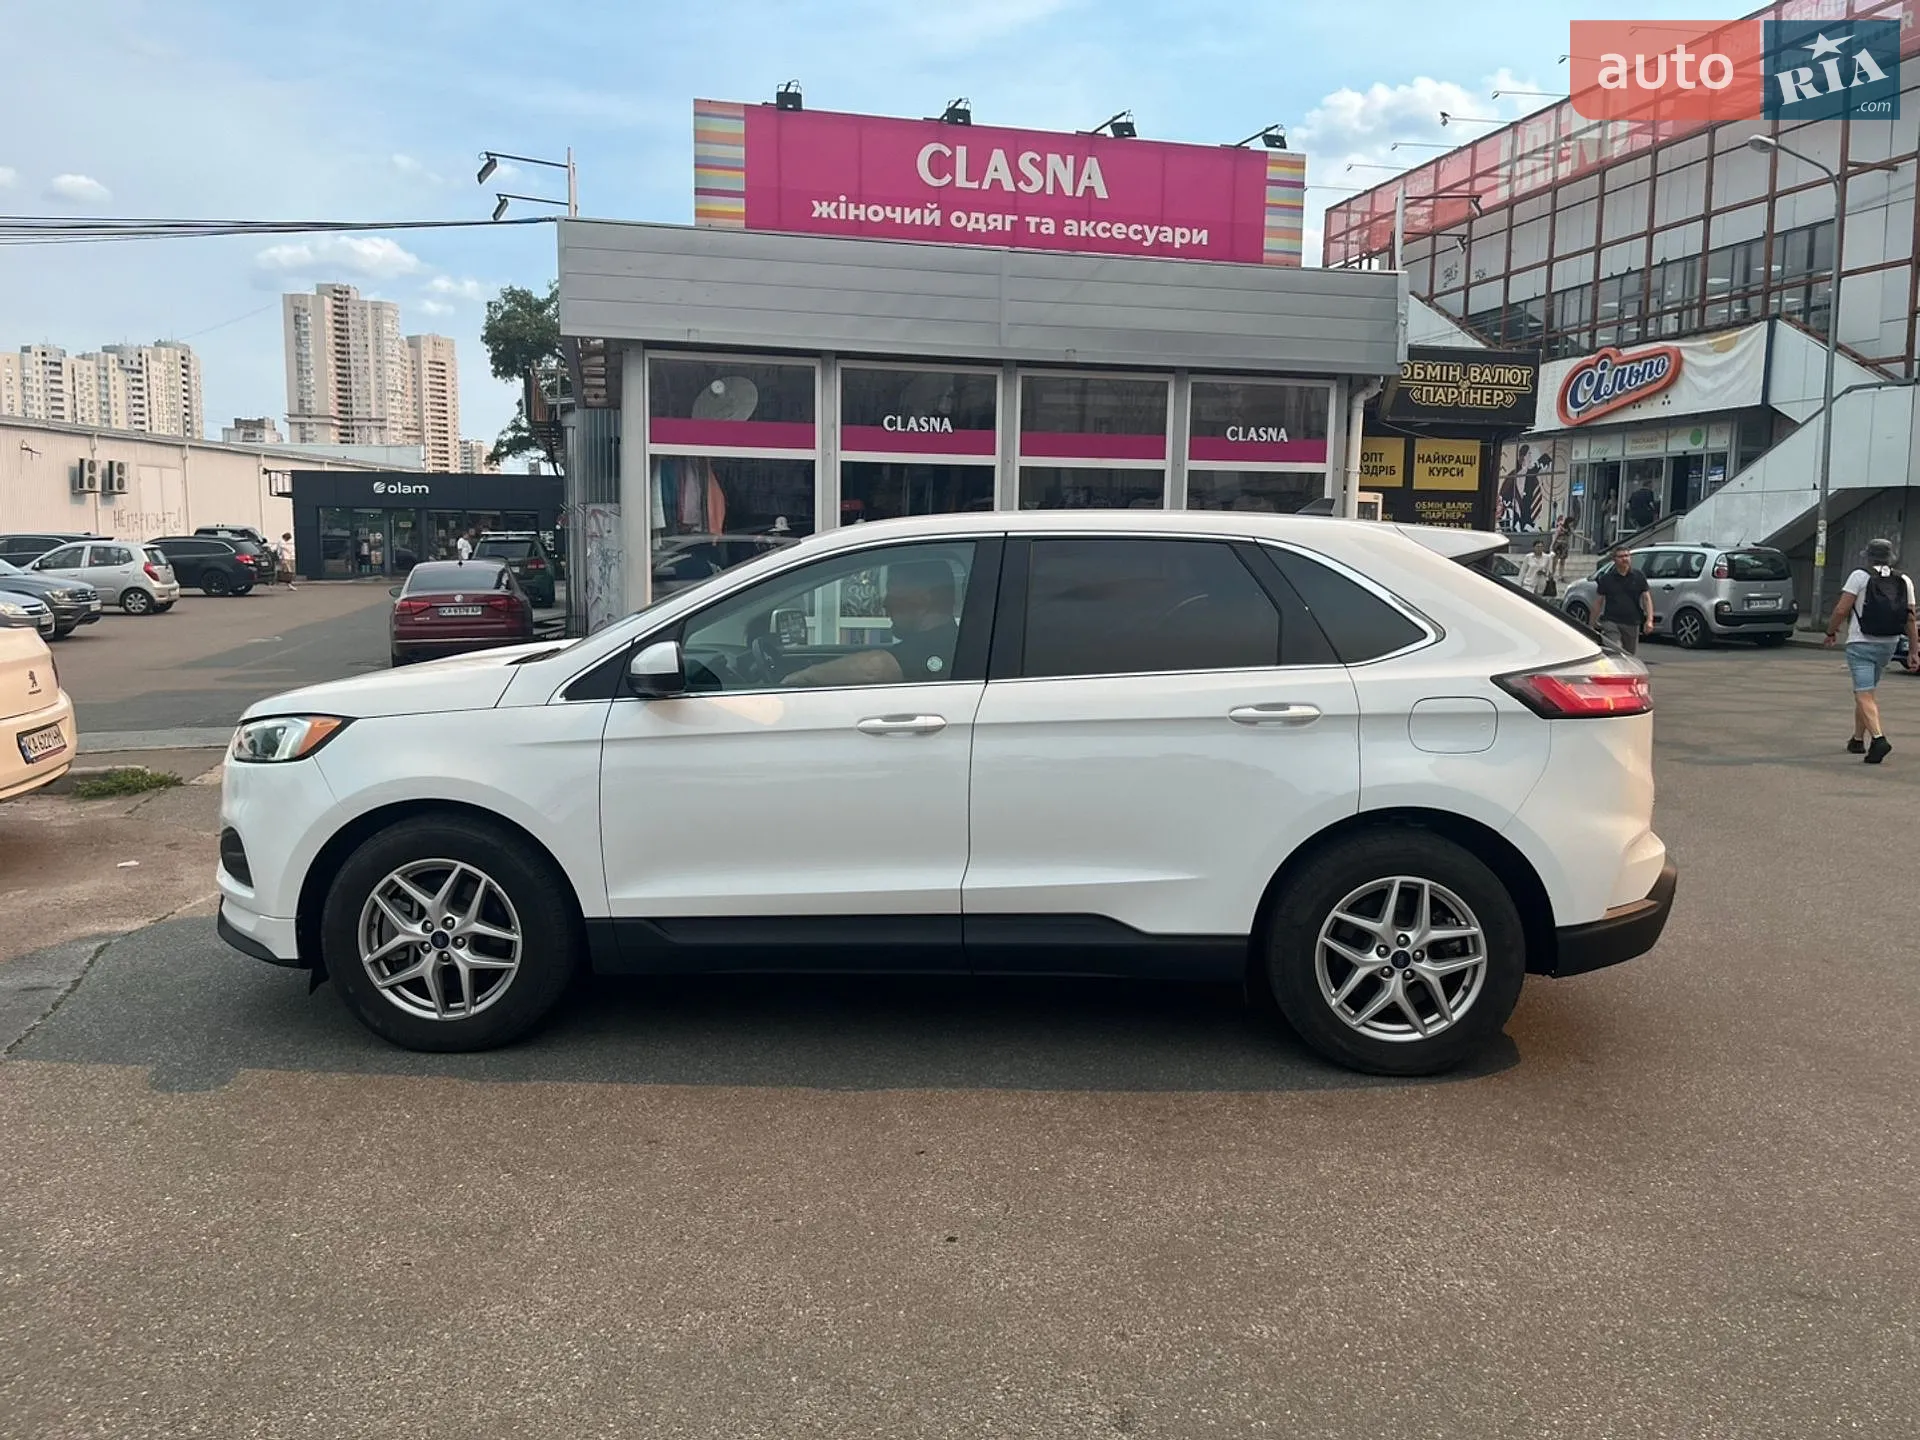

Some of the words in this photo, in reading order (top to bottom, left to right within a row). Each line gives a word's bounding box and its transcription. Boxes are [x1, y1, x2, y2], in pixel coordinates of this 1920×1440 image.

[916, 142, 1109, 199] CLASNA
[811, 195, 941, 226] жіночий
[950, 209, 1018, 233] одяг
[1027, 216, 1056, 235] та
[1064, 219, 1209, 248] аксесуари
[1402, 364, 1460, 381] ОБМІН
[1469, 366, 1531, 386] ВАЛЮТ
[1569, 356, 1668, 411] Сільпо
[882, 415, 953, 433] CLASNA
[1226, 426, 1288, 442] CLASNA
[1417, 452, 1476, 467] НАЙКРАЩІ
[1428, 466, 1464, 477] КУРСИ
[387, 482, 430, 494] olam
